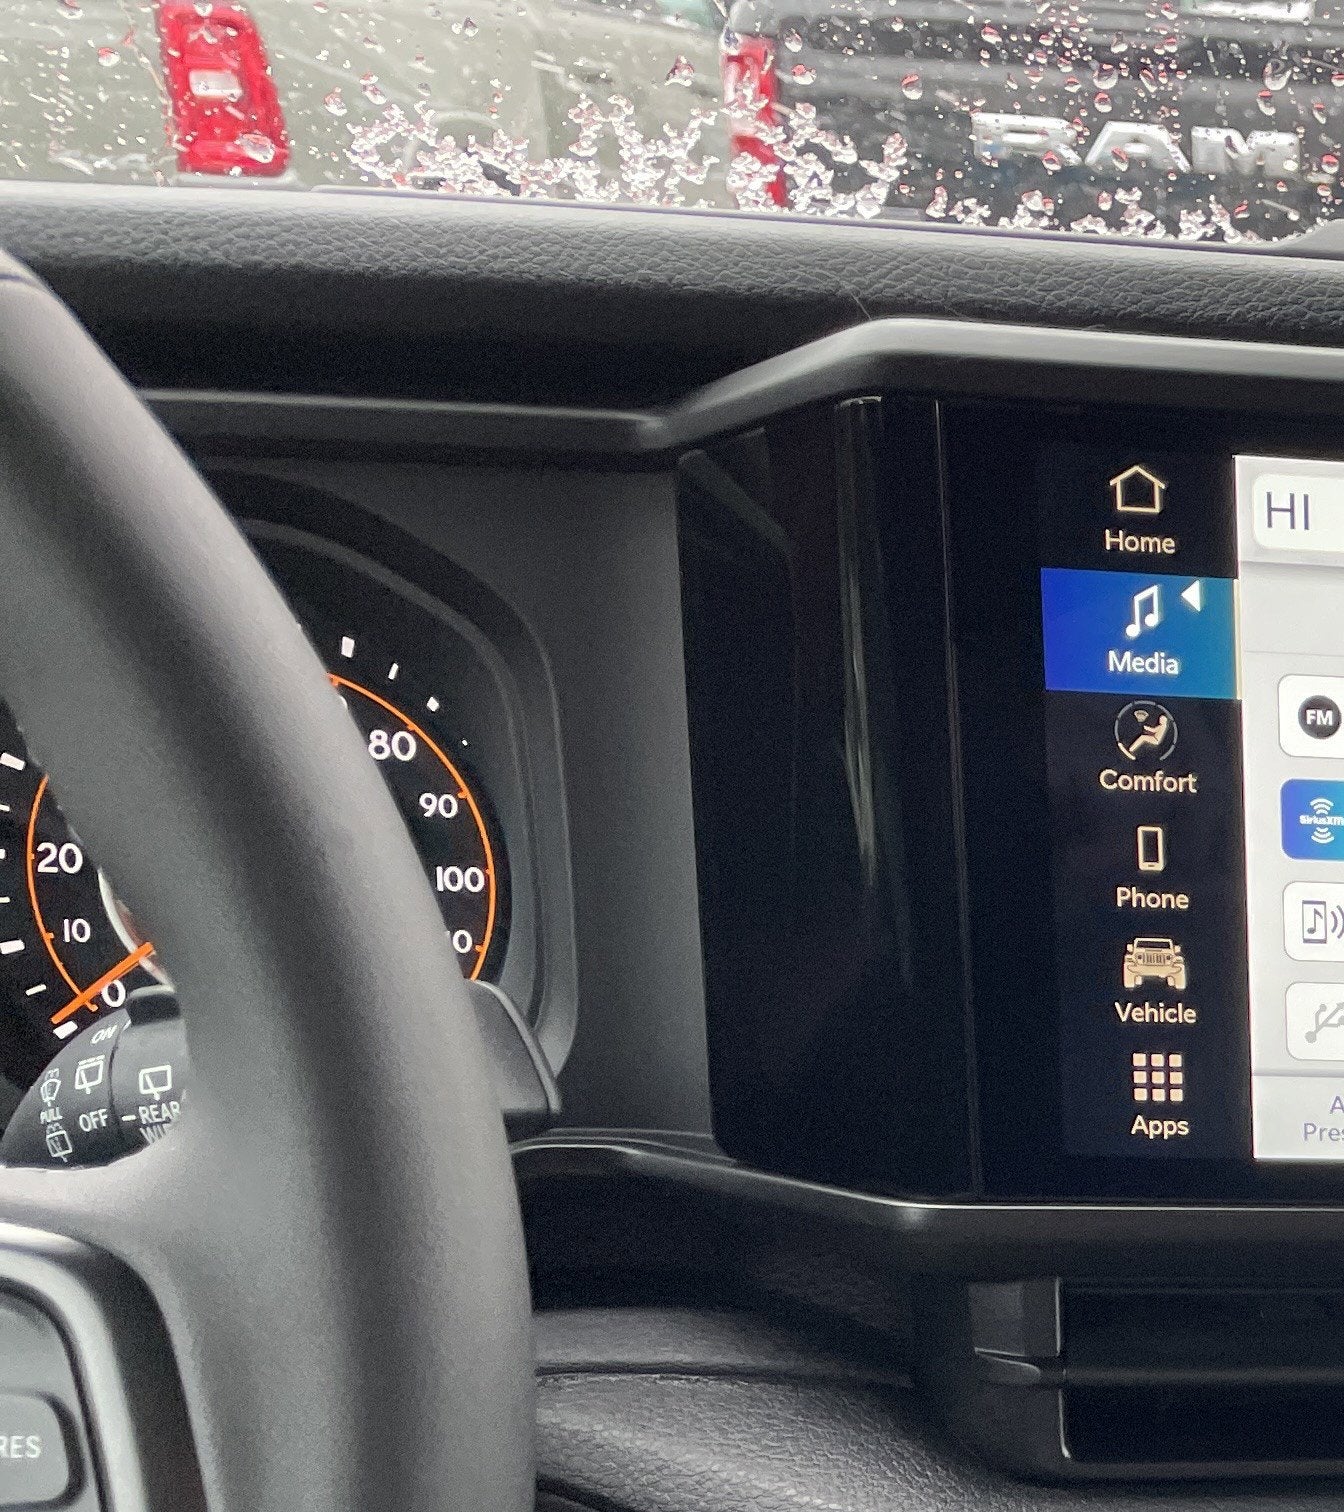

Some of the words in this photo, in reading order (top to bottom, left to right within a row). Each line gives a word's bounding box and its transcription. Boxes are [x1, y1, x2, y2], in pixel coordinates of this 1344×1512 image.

[972, 112, 1301, 176] RAM
[1265, 492, 1310, 532] HI
[1104, 530, 1175, 555] Home
[1108, 651, 1180, 674] Media
[1306, 710, 1333, 726] FM
[368, 730, 418, 762] 80
[1099, 770, 1197, 794] Comfort
[419, 792, 459, 819] 90
[37, 842, 83, 874] 20
[436, 866, 485, 893] 100
[1115, 887, 1190, 911] Phone
[62, 920, 91, 943] 10
[101, 980, 126, 1007] 0
[1114, 1003, 1197, 1026] Vehicle
[91, 1025, 117, 1044] ON
[40, 1107, 63, 1124] PULL
[79, 1108, 109, 1132] OFF
[139, 1101, 180, 1124] REAR
[1131, 1115, 1190, 1140] Apps
